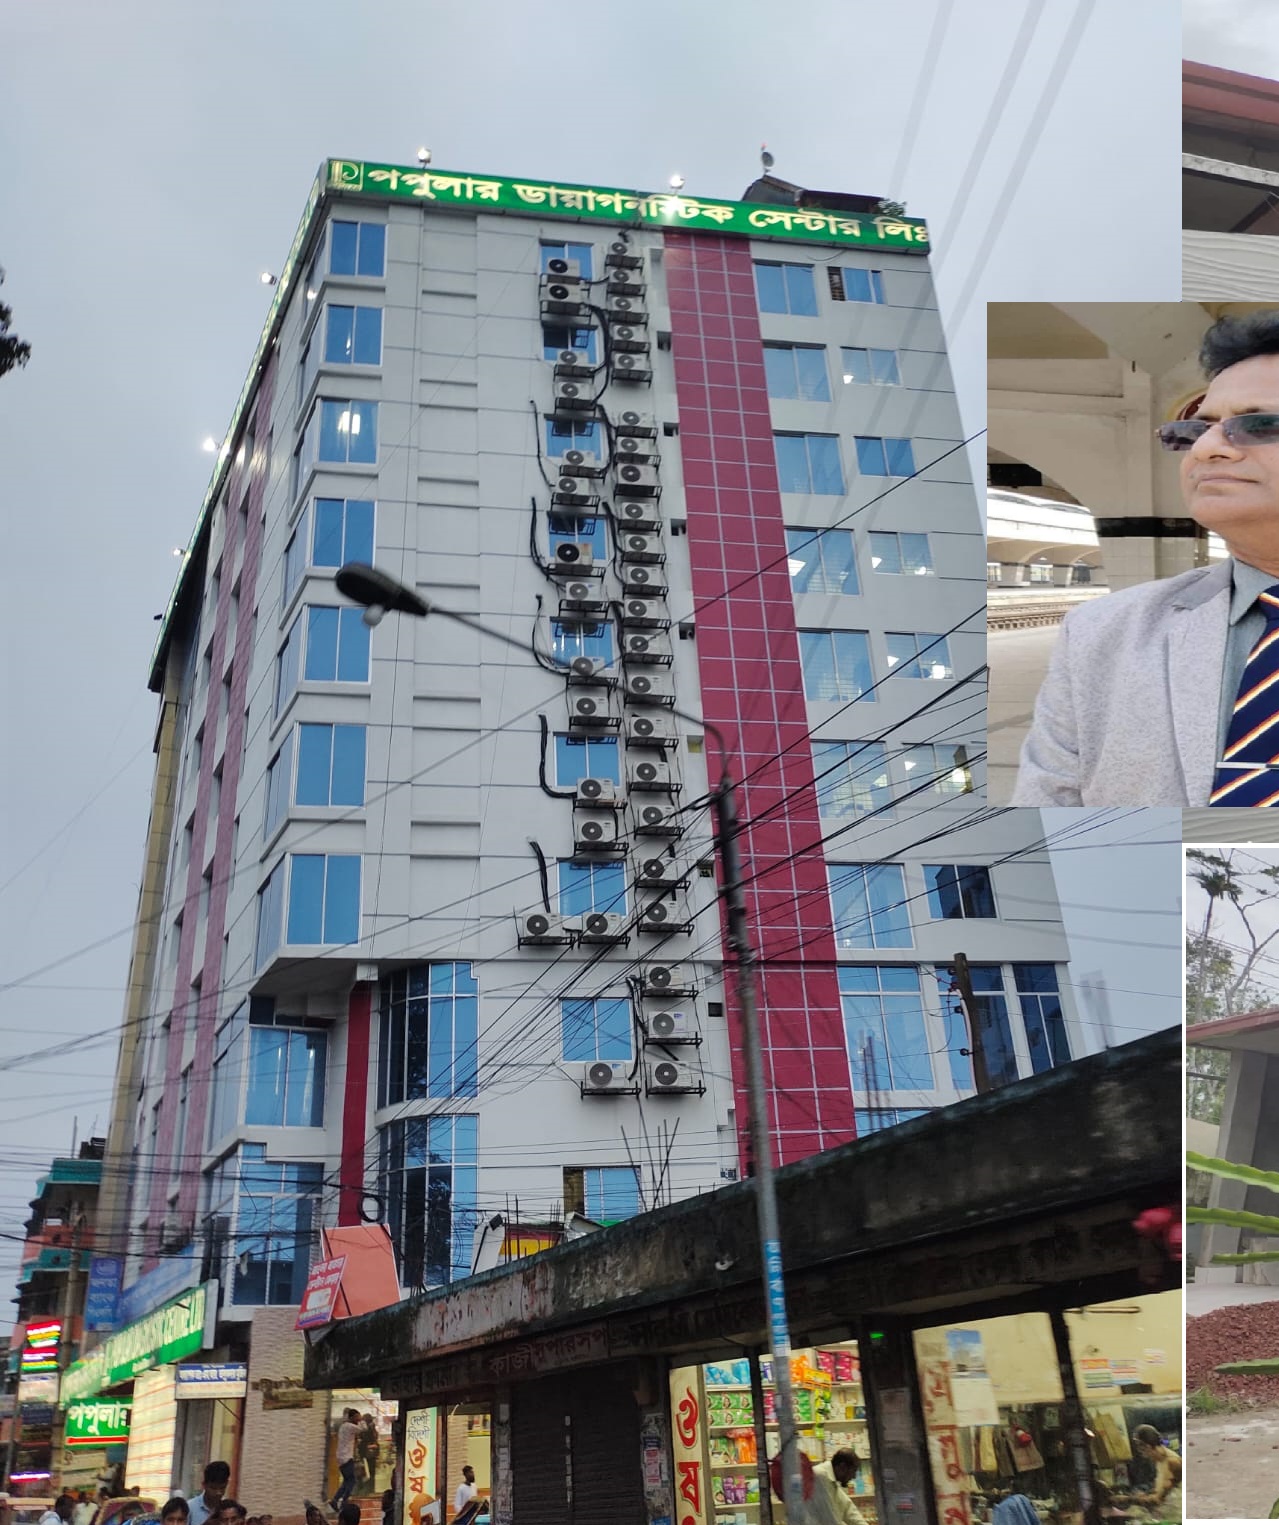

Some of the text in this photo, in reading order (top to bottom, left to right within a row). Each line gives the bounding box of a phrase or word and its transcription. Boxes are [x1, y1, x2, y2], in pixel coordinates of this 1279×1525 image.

[367, 168, 503, 202] পপুলার
[748, 208, 862, 238] সেন্টার
[870, 215, 929, 242] লিঃ
